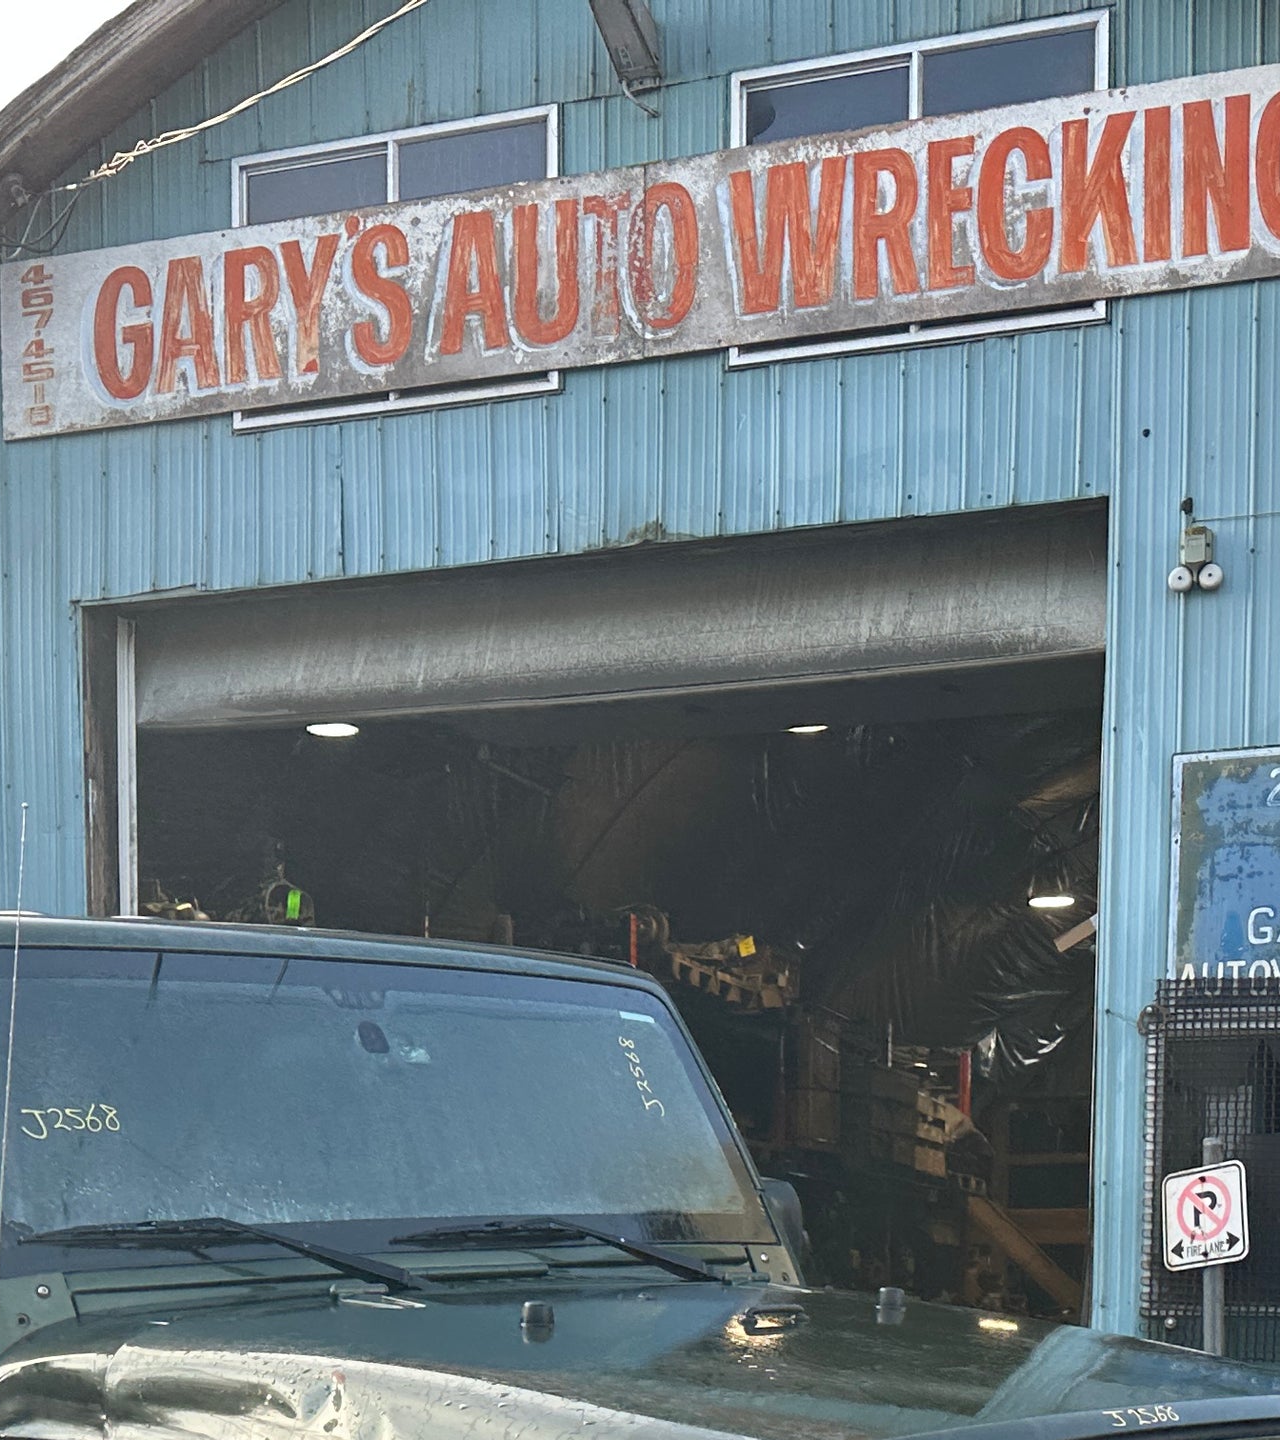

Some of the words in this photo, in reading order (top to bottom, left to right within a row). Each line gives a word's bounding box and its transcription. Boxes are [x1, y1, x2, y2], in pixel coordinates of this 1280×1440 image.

[93, 214, 413, 401] GARY'S
[441, 181, 699, 355] AUTO
[619, 1036, 665, 1117] J2568
[20, 1102, 122, 1140] J2568
